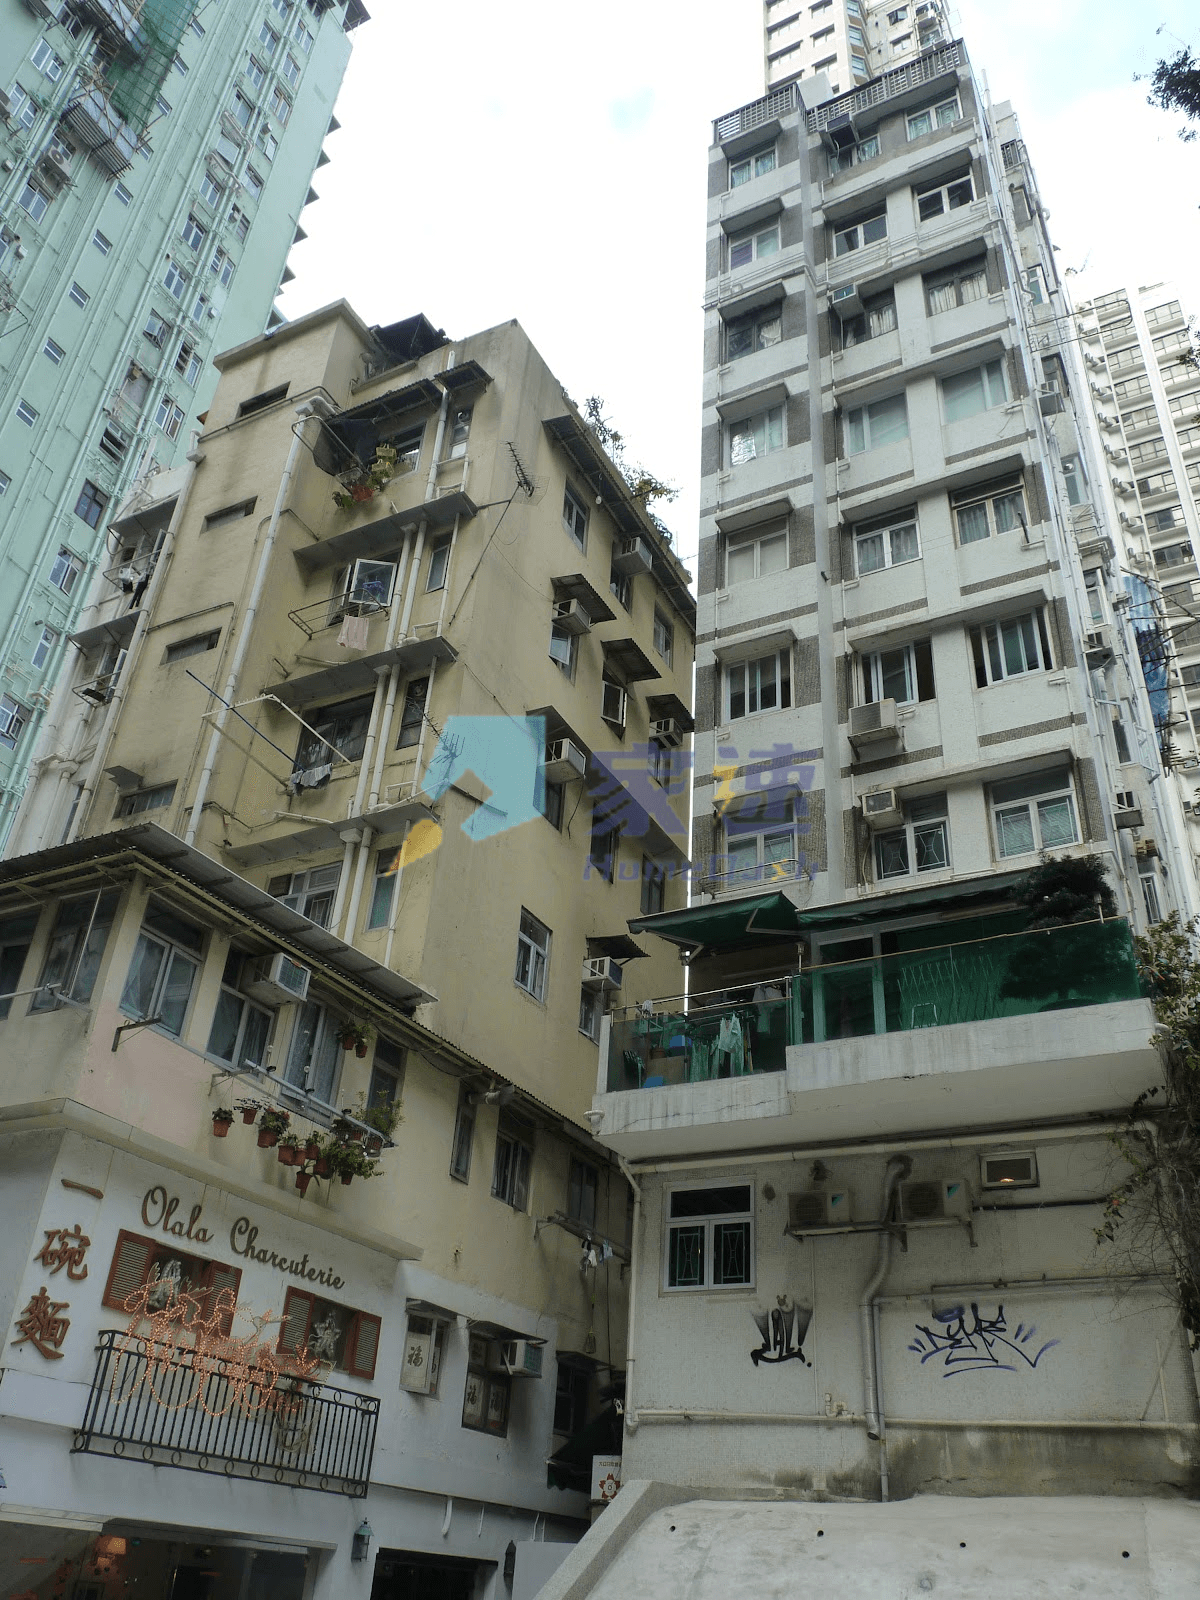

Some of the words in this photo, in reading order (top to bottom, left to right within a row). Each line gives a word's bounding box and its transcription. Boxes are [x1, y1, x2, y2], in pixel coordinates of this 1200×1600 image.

[10, 1179, 104, 1360] 一碗麵
[141, 1185, 214, 1243] Olala
[230, 1216, 345, 1290] Charcuterie
